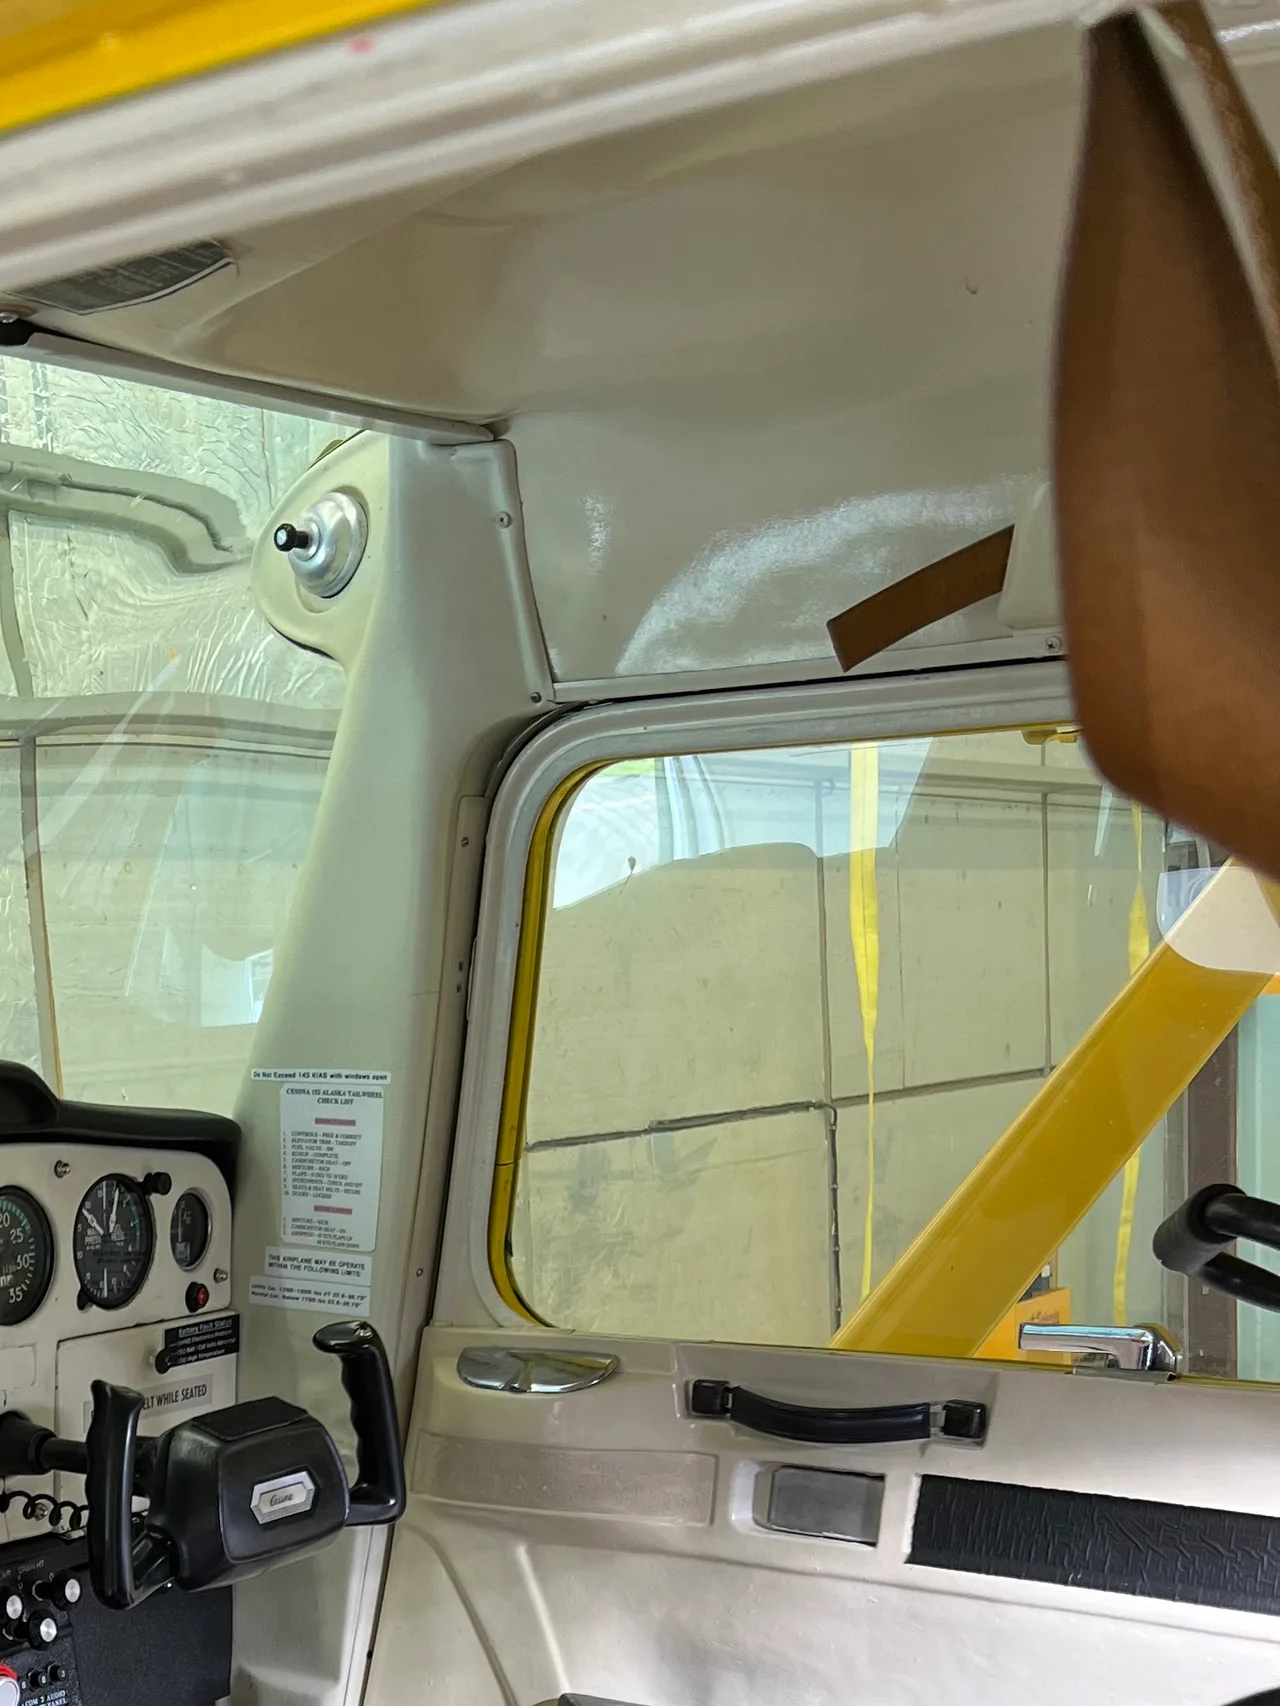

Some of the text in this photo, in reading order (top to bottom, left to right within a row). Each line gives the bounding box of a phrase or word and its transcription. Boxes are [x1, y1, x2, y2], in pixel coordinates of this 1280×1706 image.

[273, 1071, 296, 1079] Exceed
[330, 1072, 343, 1080] with
[322, 1089, 347, 1097] ALASKA
[347, 1090, 383, 1099] TAILWHEEL
[10, 1228, 24, 1244] 25
[268, 1254, 280, 1263] THIS
[282, 1255, 312, 1265] AIRPLANE
[314, 1258, 327, 1266] MAY
[338, 1260, 365, 1271] OPERATE
[303, 1265, 340, 1275] FOLLOWING
[341, 1269, 361, 1278] LIMITS
[8, 1287, 23, 1304] 35
[155, 1384, 207, 1406] WHILE SEATED
[46, 1690, 66, 1702] AUDIO
